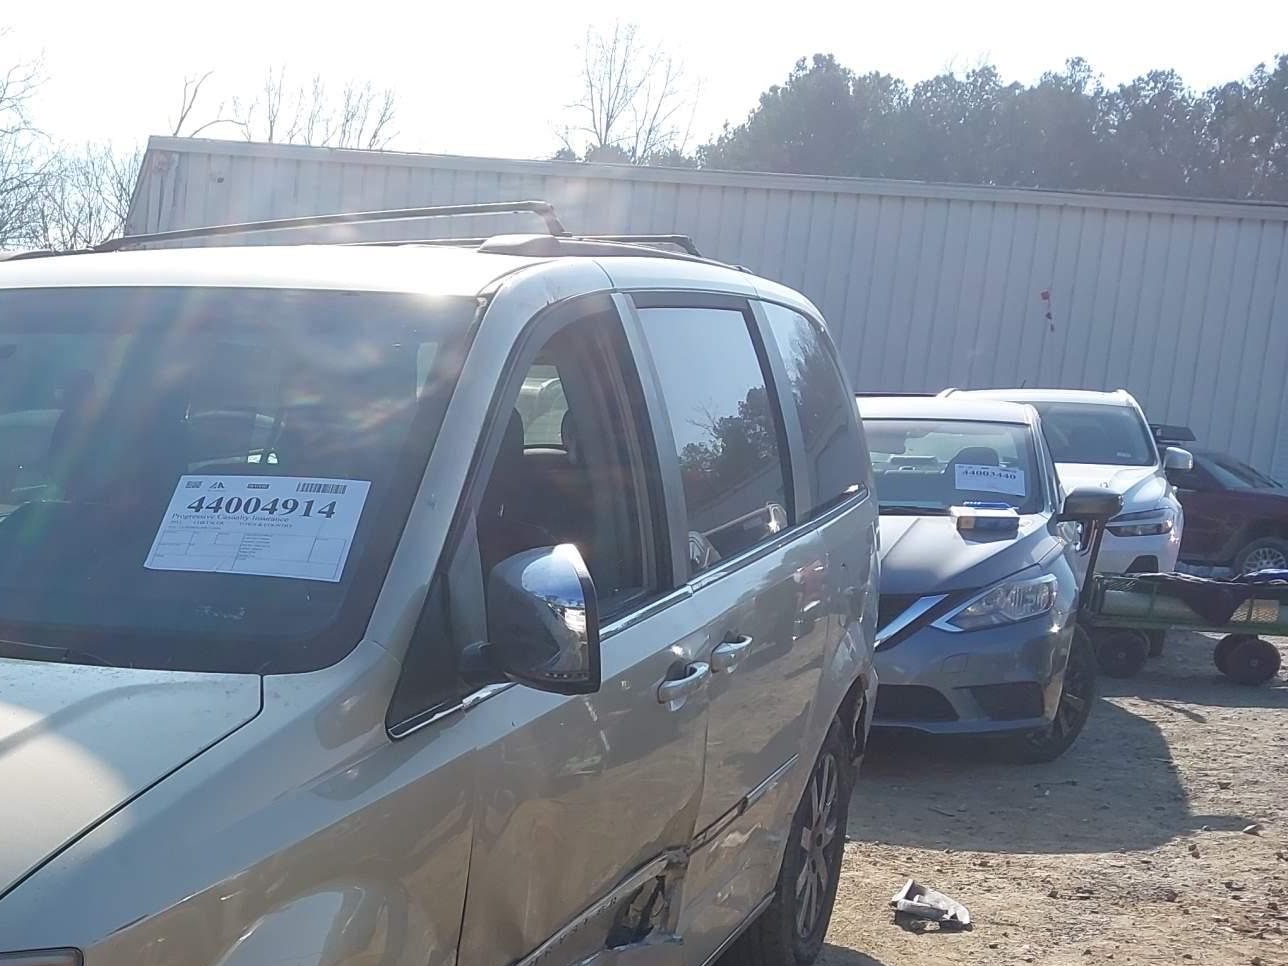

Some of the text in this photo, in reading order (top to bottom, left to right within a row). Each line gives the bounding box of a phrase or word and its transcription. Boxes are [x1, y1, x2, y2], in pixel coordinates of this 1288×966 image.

[186, 495, 337, 518] 44004914
[171, 512, 289, 523] Progressive Casualty Insurance
